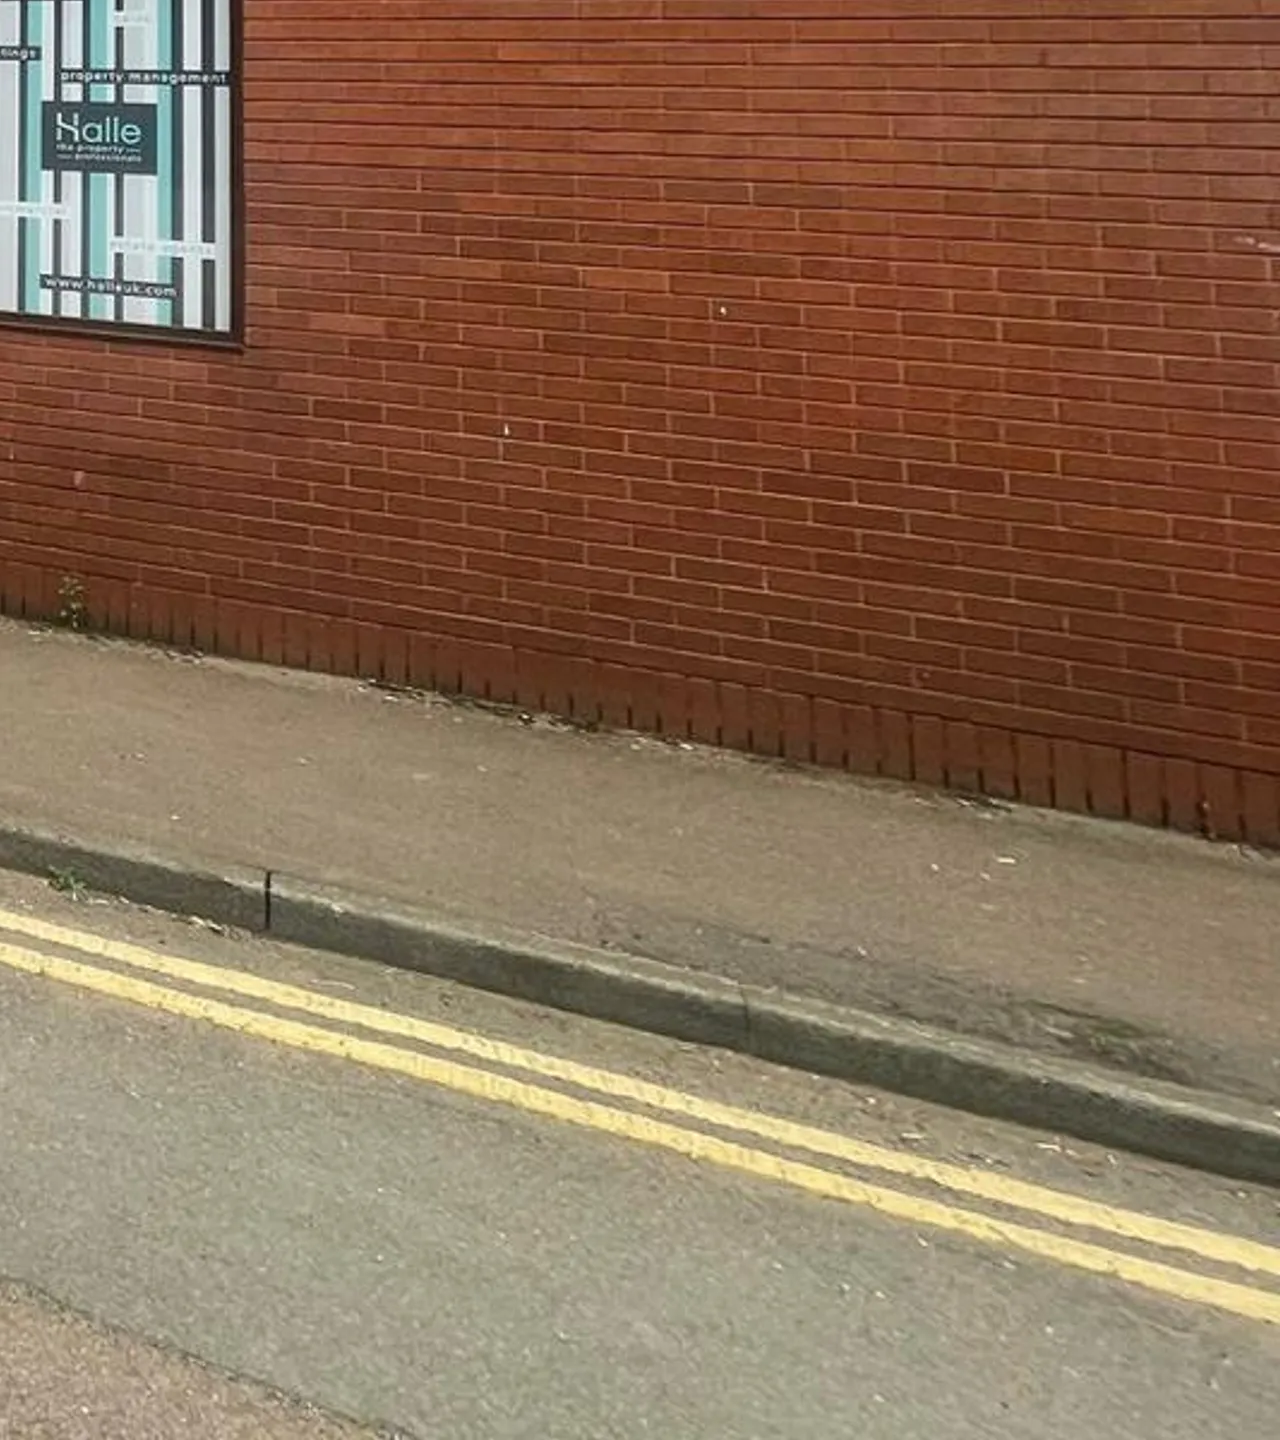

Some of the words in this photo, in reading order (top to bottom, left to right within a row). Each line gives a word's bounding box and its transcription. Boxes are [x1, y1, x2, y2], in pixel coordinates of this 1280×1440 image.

[60, 70, 125, 84] property
[129, 71, 227, 85] management
[56, 112, 142, 144] Halle
